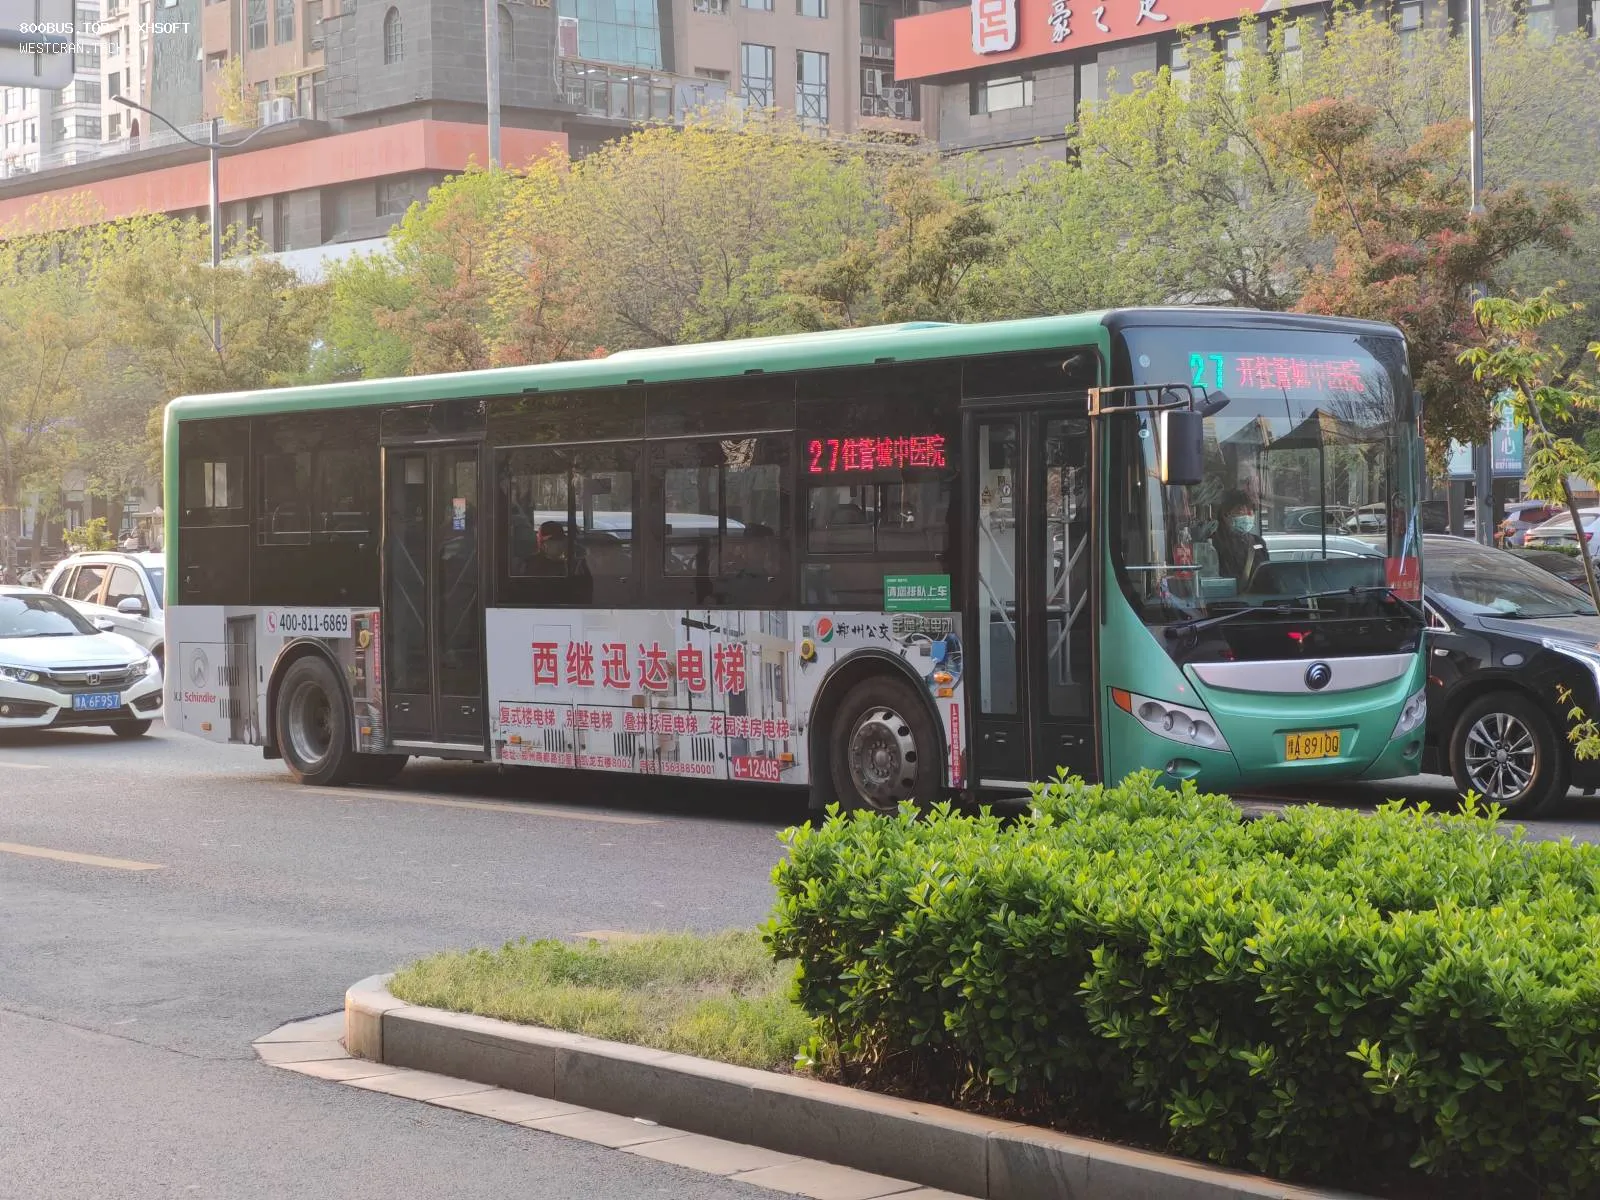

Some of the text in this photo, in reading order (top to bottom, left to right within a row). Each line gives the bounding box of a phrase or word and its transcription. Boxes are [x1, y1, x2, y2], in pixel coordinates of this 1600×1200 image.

[1190, 352, 1224, 390] 27
[279, 614, 348, 632] 400-811-6869
[836, 621, 891, 642] 郑州公交
[531, 640, 747, 695] 西继迅达电梯
[184, 691, 216, 704] Schindler
[500, 706, 791, 740] 复式楼电梯 别墅电梯 叠拼跃层电梯 花园洋房电梯
[734, 758, 779, 780] 4-12405
